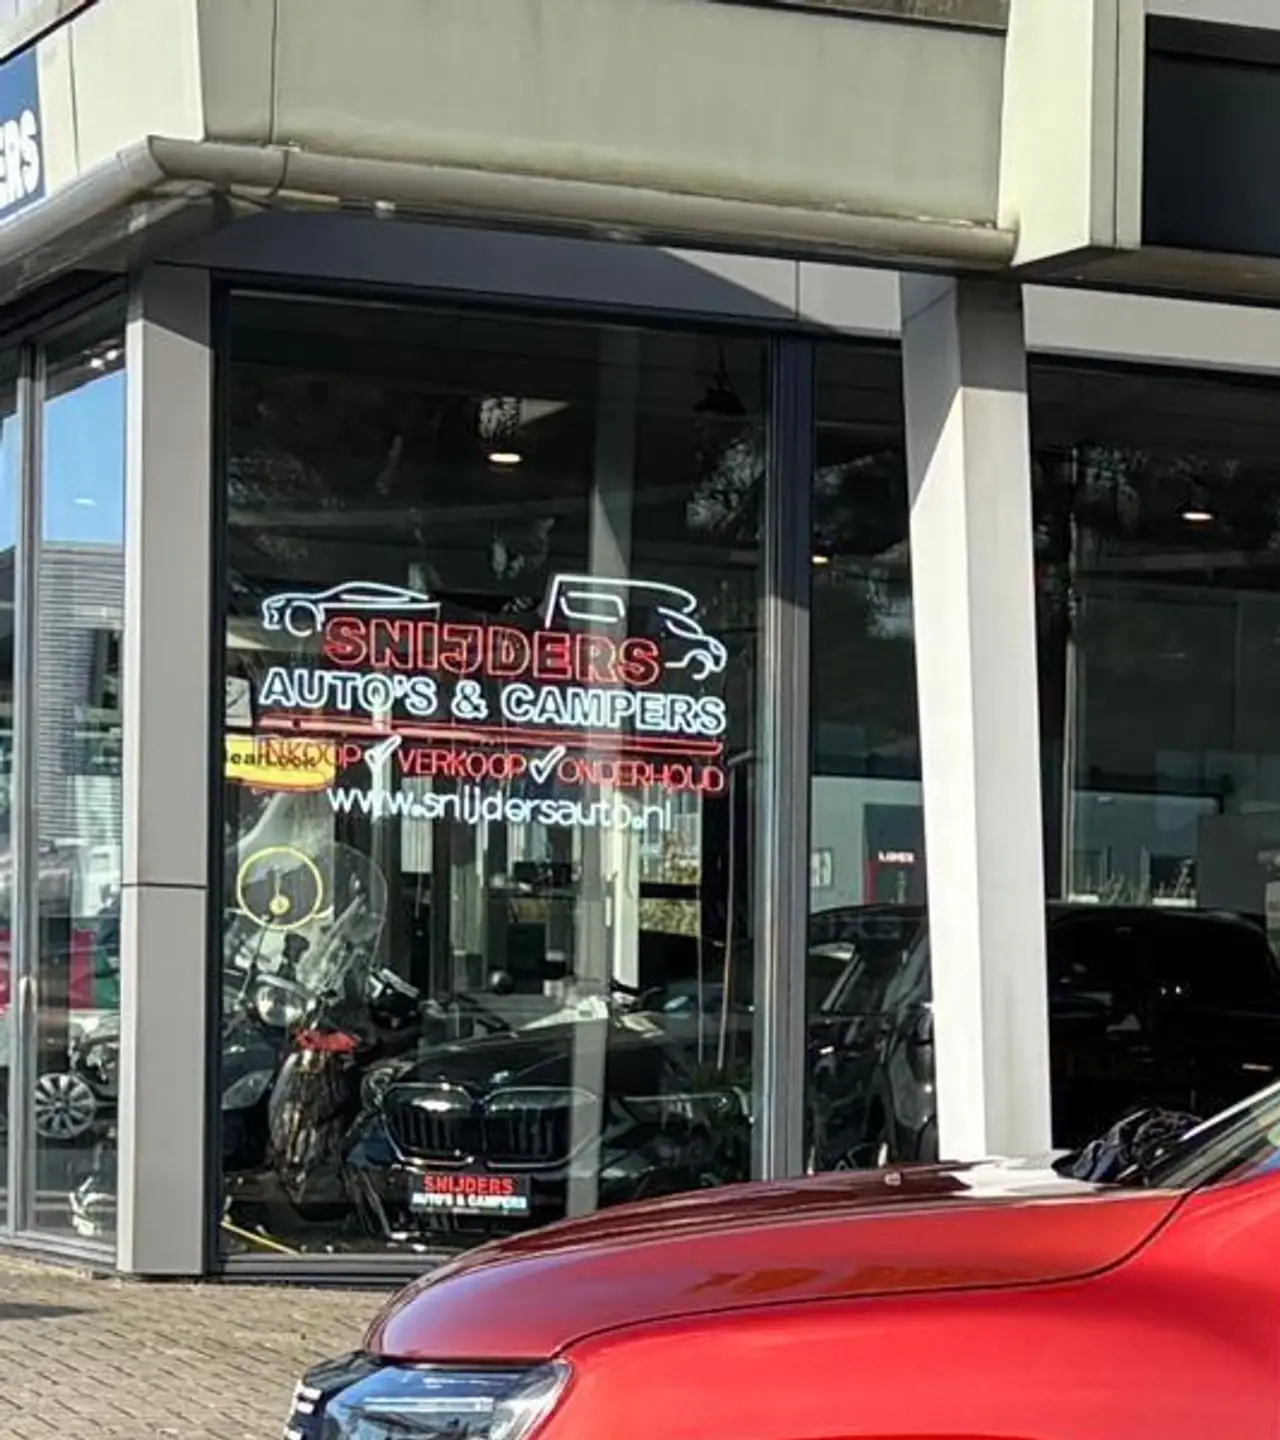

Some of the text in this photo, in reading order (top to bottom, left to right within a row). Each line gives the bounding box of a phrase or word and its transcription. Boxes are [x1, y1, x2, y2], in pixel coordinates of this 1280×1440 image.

[325, 616, 660, 685] SNIJDERS
[258, 667, 726, 736] AUTO'S & CAMPERS
[398, 747, 528, 779] VERKOOP
[557, 756, 725, 792] ONDERHOUD
[424, 1175, 513, 1195] SNIJDERS
